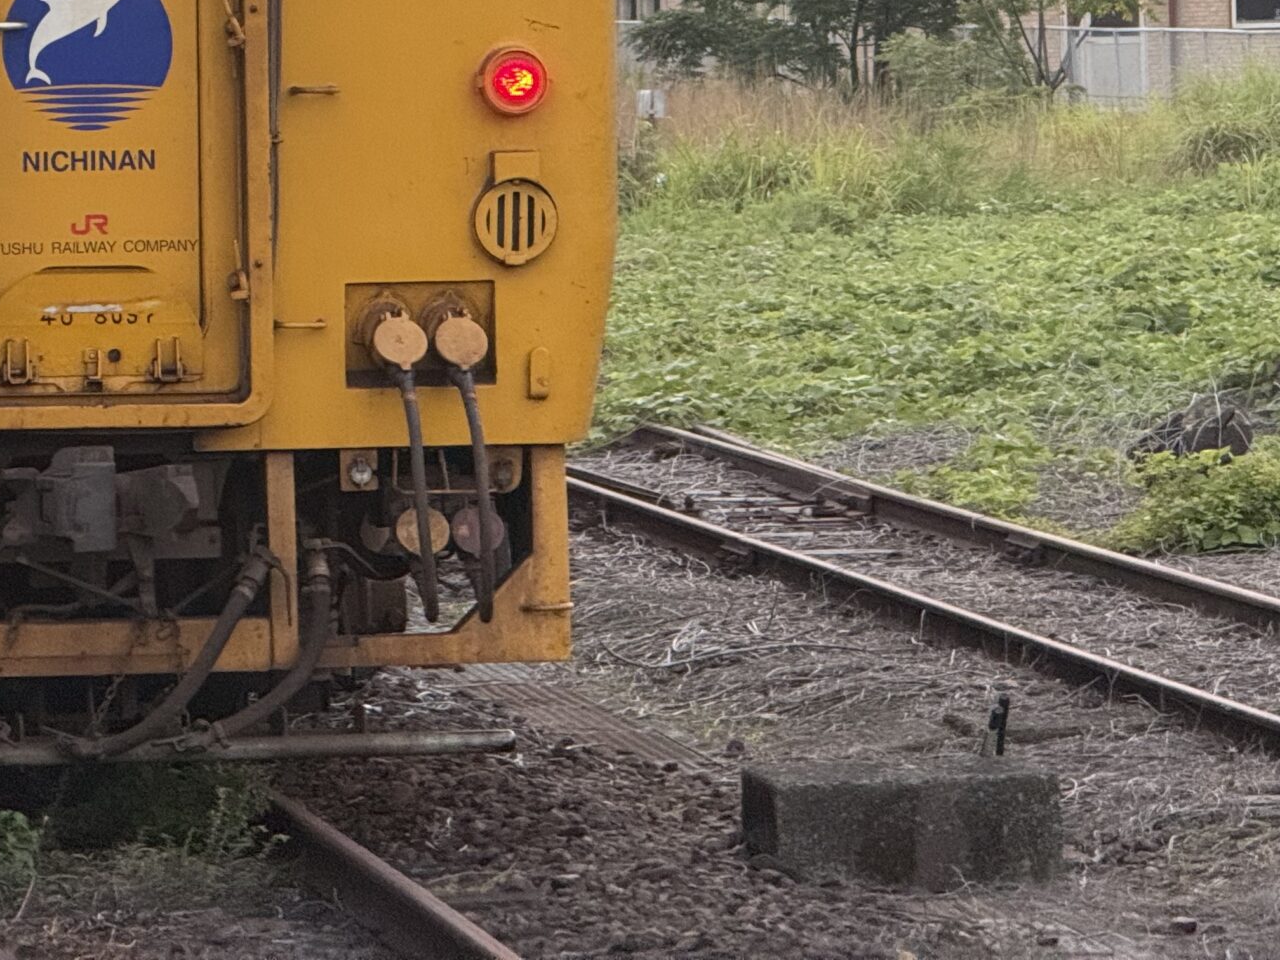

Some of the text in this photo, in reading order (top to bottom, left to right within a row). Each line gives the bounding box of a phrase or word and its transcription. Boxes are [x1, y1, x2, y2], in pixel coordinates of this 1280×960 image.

[22, 149, 156, 172] NICHINAN
[71, 214, 109, 236] JR
[51, 240, 117, 255] RAILWAY
[123, 238, 199, 254] COMPANY
